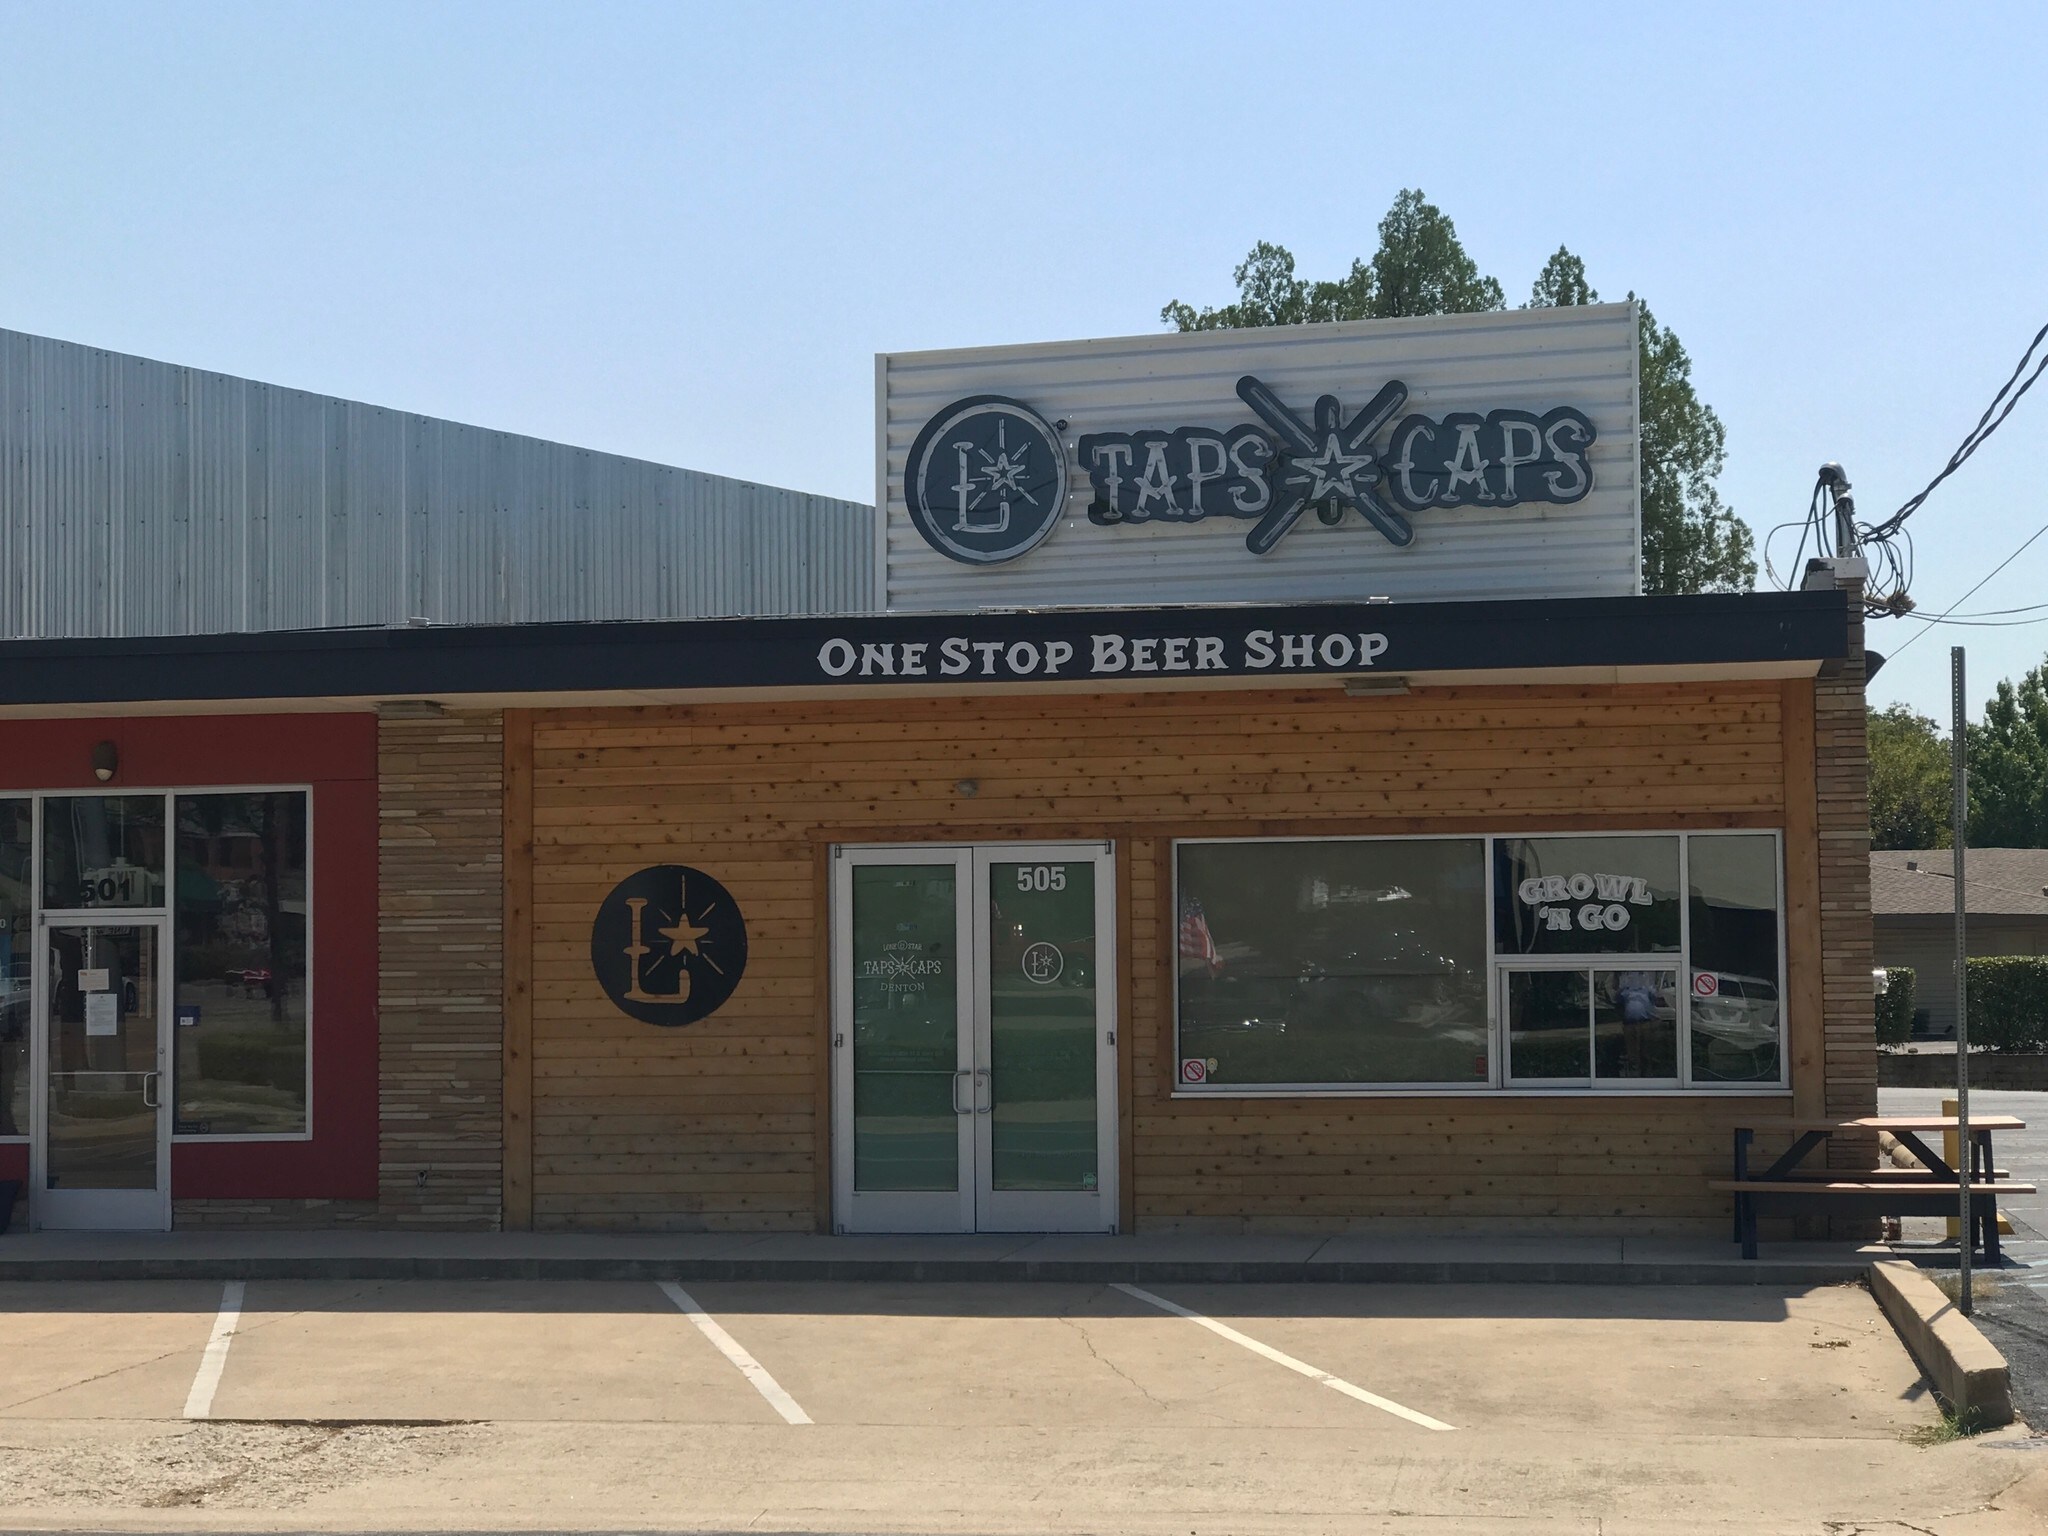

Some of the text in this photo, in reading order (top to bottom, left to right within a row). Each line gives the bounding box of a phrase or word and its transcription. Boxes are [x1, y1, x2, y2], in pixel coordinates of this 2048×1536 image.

[1092, 418, 1592, 518] TAPS CAPS
[816, 630, 1390, 677] ONE STOP BEER SHOP
[80, 877, 130, 902] 501
[1017, 866, 1067, 891] 505
[1518, 873, 1653, 905] GROWL
[1577, 904, 1631, 931] GO
[864, 960, 942, 975] TAPS CAPS
[880, 982, 925, 992] DENTON
